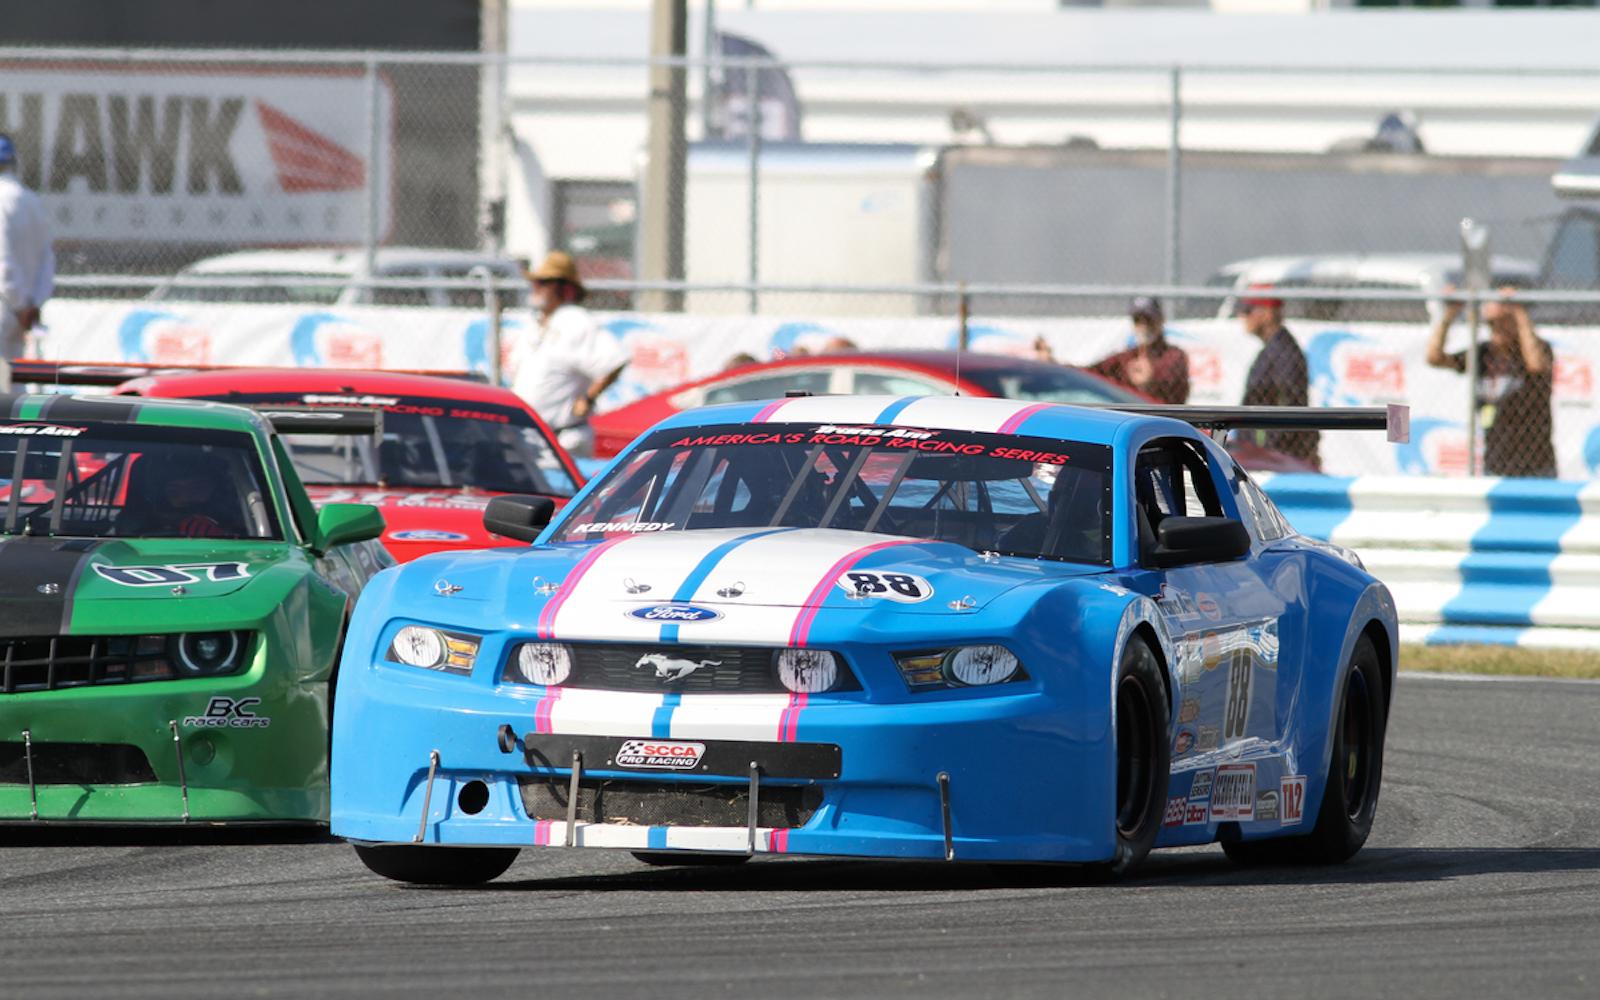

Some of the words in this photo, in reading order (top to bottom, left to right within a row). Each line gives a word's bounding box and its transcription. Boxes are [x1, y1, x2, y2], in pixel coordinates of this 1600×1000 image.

[0, 93, 243, 196] HAWK
[36, 426, 81, 437] Am
[816, 425, 886, 437] Trans
[883, 428, 931, 440] Am
[671, 433, 805, 448] AMERICA'S
[808, 433, 880, 446] ROAD
[886, 438, 985, 455] RACING
[989, 447, 1070, 465] SERIES
[573, 522, 675, 534] KENNEDY
[847, 573, 921, 598] 88
[645, 605, 700, 620] Ford
[1225, 647, 1252, 738] 88
[205, 697, 262, 717] BC
[183, 716, 228, 728] race
[229, 717, 271, 728] cars
[643, 745, 697, 757] SCCA
[619, 756, 645, 764] PRO
[645, 757, 695, 766] RACING
[1282, 782, 1302, 818] TA2
